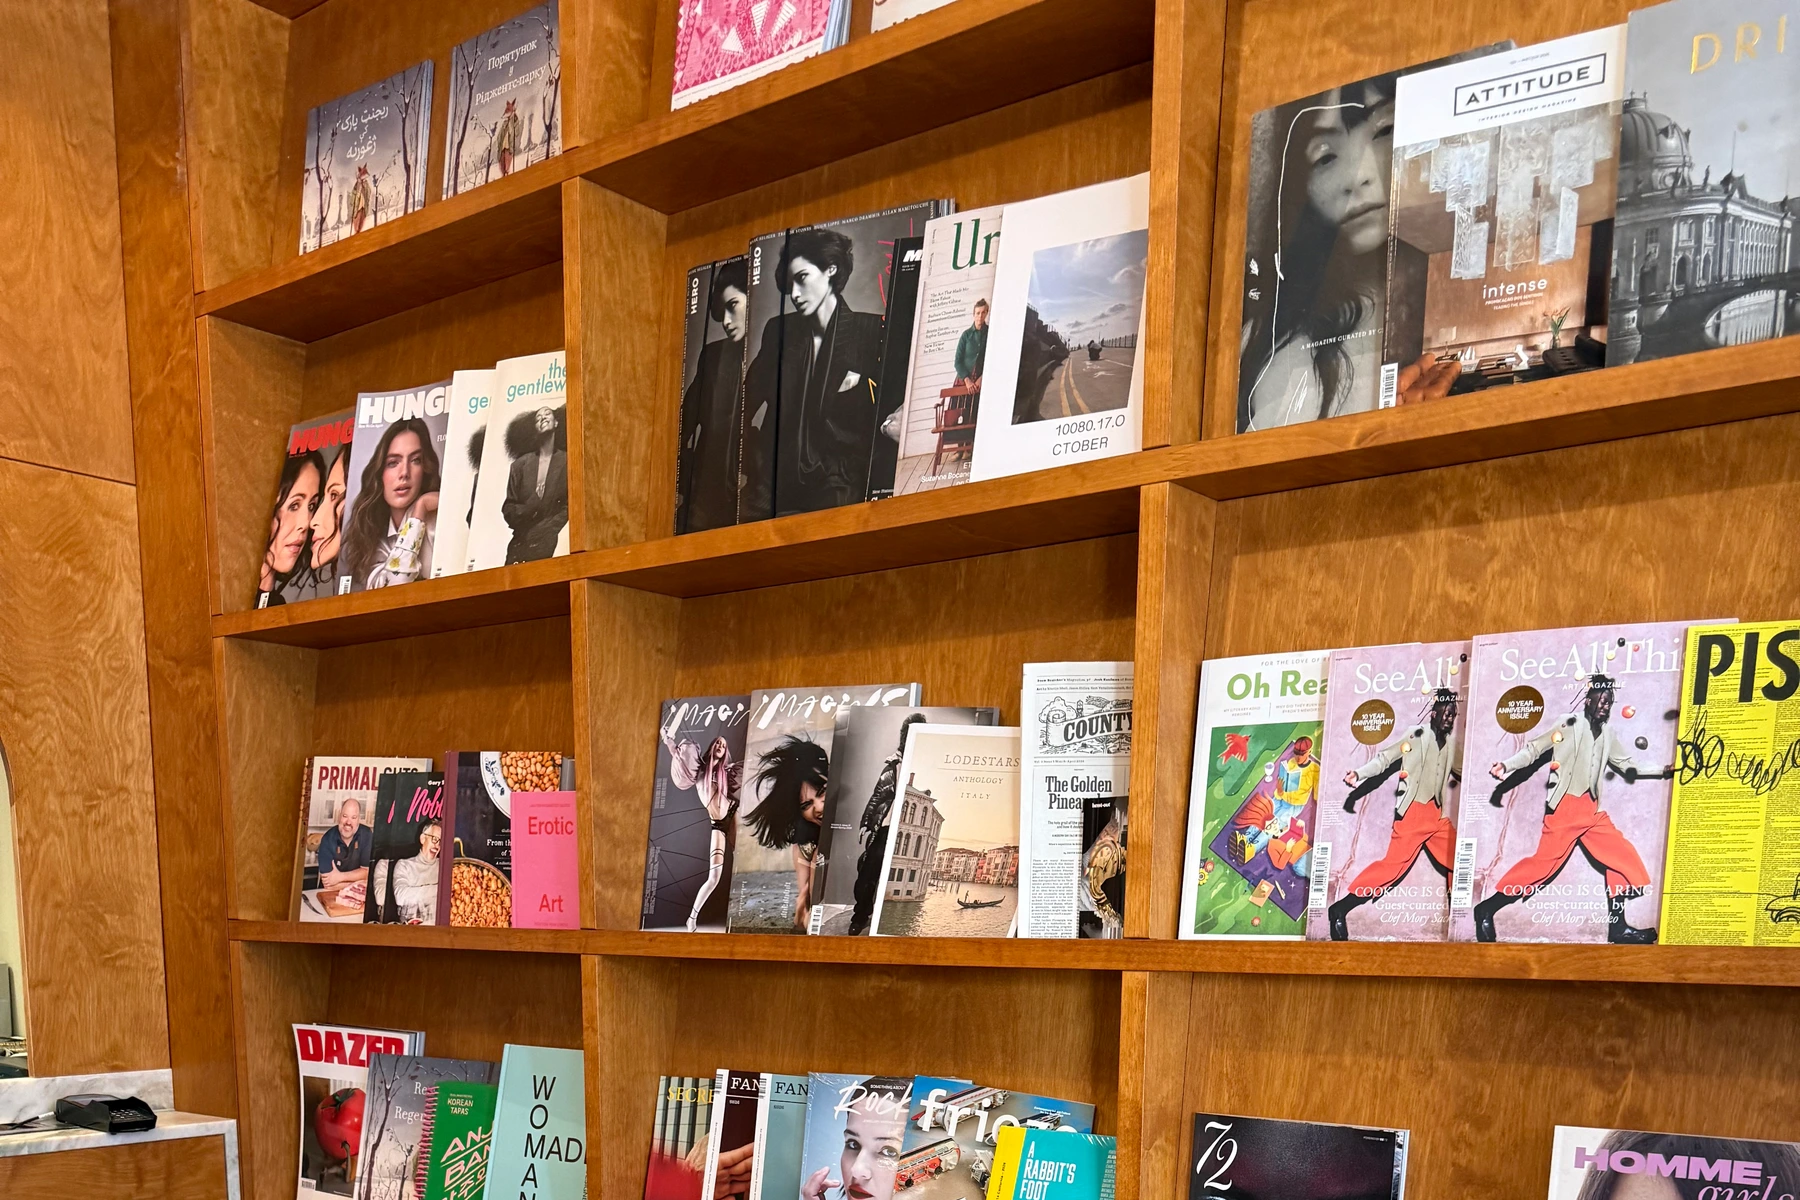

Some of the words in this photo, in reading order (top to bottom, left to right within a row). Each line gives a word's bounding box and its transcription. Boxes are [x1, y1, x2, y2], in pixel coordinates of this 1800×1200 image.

[487, 40, 537, 71] Порятунок
[1465, 65, 1591, 106] ATTITUDE
[752, 246, 762, 286] HERO
[690, 277, 700, 315] HERO
[1483, 278, 1548, 299] intense
[1052, 436, 1110, 457] CTOBER
[1500, 649, 1557, 682] See
[1555, 640, 1613, 678] All
[1692, 628, 1800, 706] PIS
[1354, 663, 1406, 694] See
[1404, 656, 1454, 692] All
[1227, 672, 1270, 700] Oh
[1280, 670, 1328, 697] Rea
[1562, 683, 1579, 691] ART
[1581, 681, 1626, 690] MAGAZINE
[1411, 696, 1427, 704] ART
[1497, 706, 1543, 714] ANNIVERSARY
[1509, 712, 1529, 720] ISSUE
[1352, 718, 1394, 726] ANNIVERSARY
[1363, 724, 1381, 732] ISSUE
[944, 754, 1021, 768] LODESTARS
[317, 765, 379, 791] PRIMAL
[953, 776, 1004, 785] ANTHOLOGY
[1045, 776, 1068, 792] The
[1070, 775, 1112, 792] Golden
[961, 792, 991, 800] ITALY
[528, 816, 574, 835] Erotic
[1354, 886, 1421, 898] COOKING
[1421, 886, 1433, 897] IS
[1503, 884, 1575, 897] COOKING
[1576, 884, 1590, 896] IS
[1593, 884, 1654, 897] CARING
[539, 893, 564, 913] Art
[1375, 900, 1449, 911] Guest-curated
[1526, 898, 1608, 911] Guest-curated
[1611, 898, 1627, 913] by
[1380, 911, 1402, 926] Chef
[1402, 912, 1429, 926] Mory
[1531, 910, 1556, 925] Chef
[1556, 911, 1588, 925] Mory
[1588, 911, 1619, 924] Sacko
[447, 1098, 474, 1108] KOREAN
[450, 1107, 469, 1115] TAPAS
[1028, 1141, 1035, 1158] A
[1196, 1120, 1238, 1191] 72
[1023, 1158, 1077, 1184] RABBIT'S
[1573, 1147, 1763, 1187] HOMME
